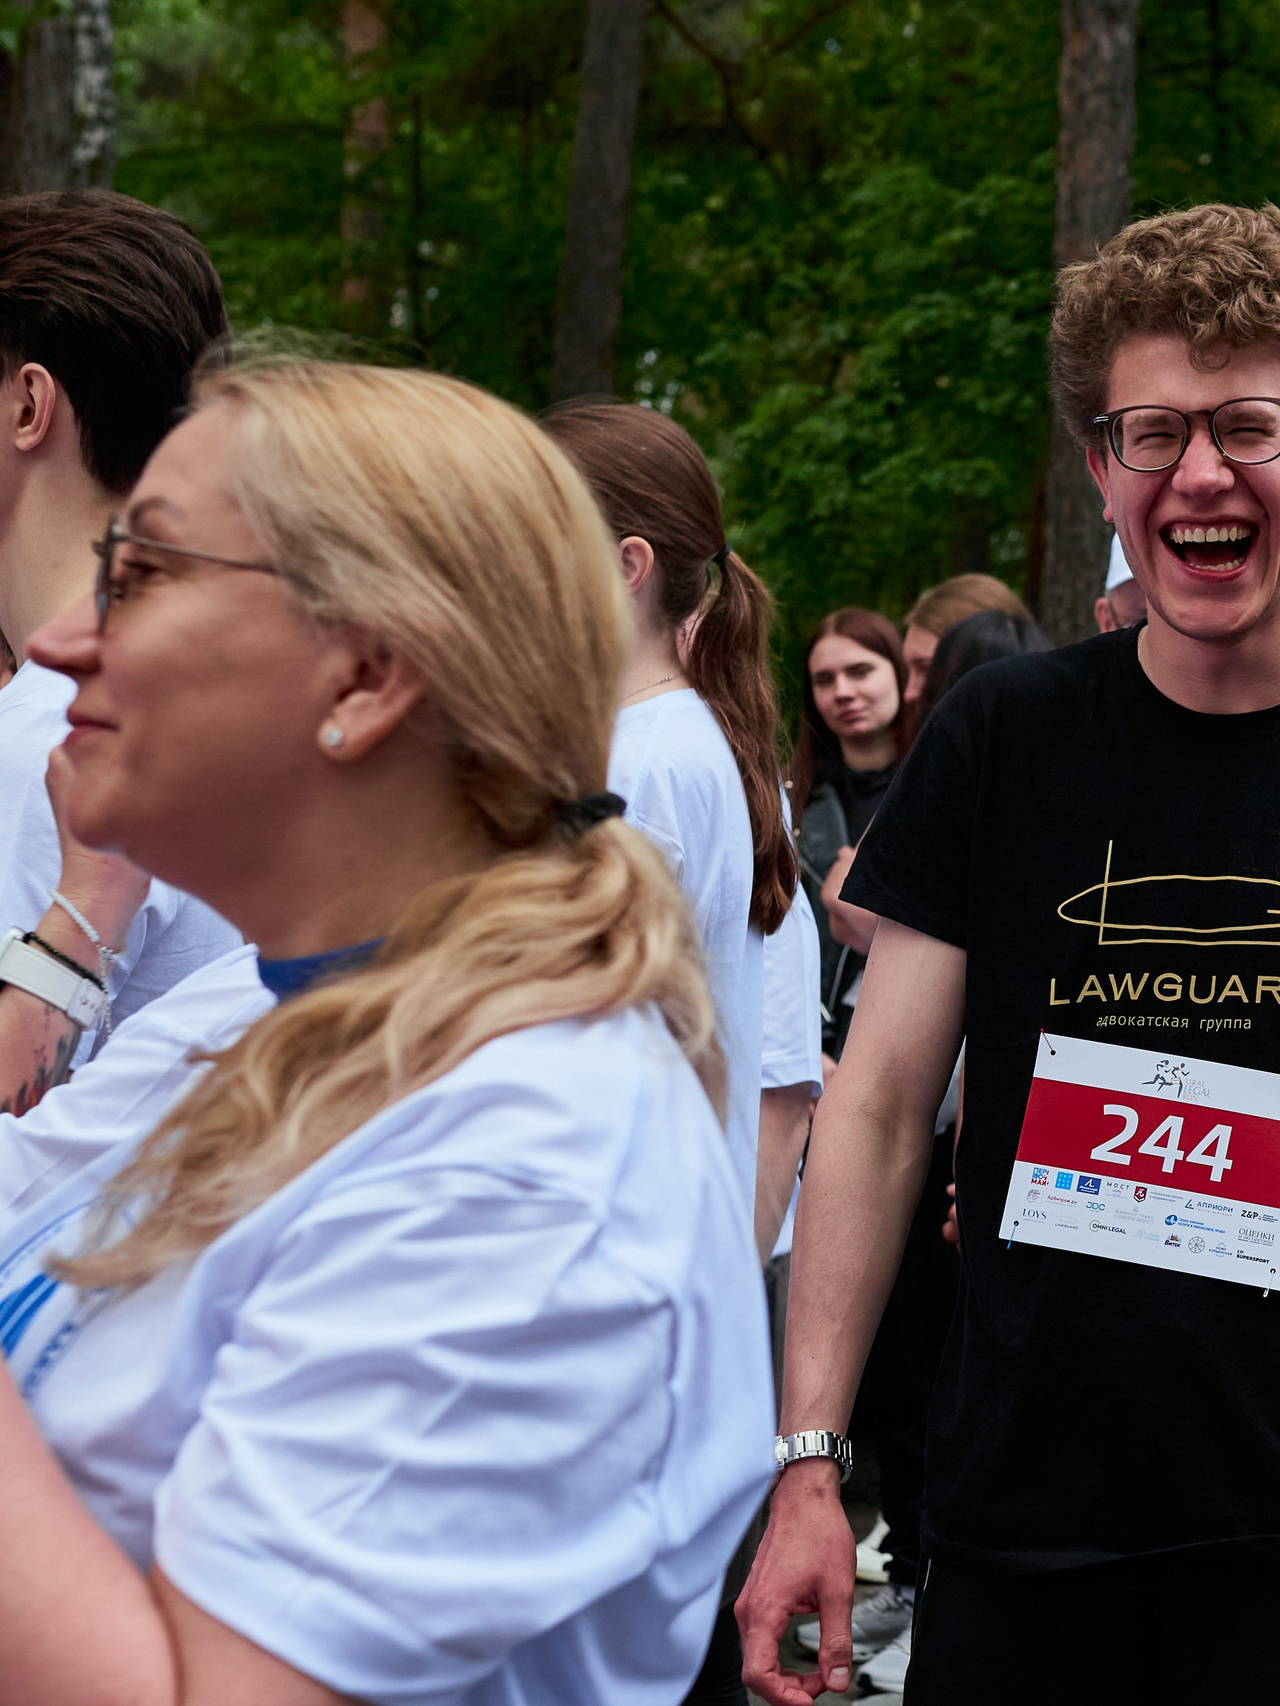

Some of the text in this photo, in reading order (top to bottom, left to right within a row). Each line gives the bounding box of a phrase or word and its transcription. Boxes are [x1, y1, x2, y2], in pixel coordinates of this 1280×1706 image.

[1096, 1015, 1252, 1032] адвокатская группа
[1183, 1085, 1211, 1098] LEGAL
[1090, 1104, 1234, 1183] 244
[1106, 1182, 1130, 1190] МОСТ
[1196, 1201, 1233, 1213] АПРИОРИ
[1022, 1208, 1047, 1220] LOYS
[1092, 1223, 1126, 1235] OMNI LEGAL
[1236, 1254, 1270, 1264] SUPERSPORT
